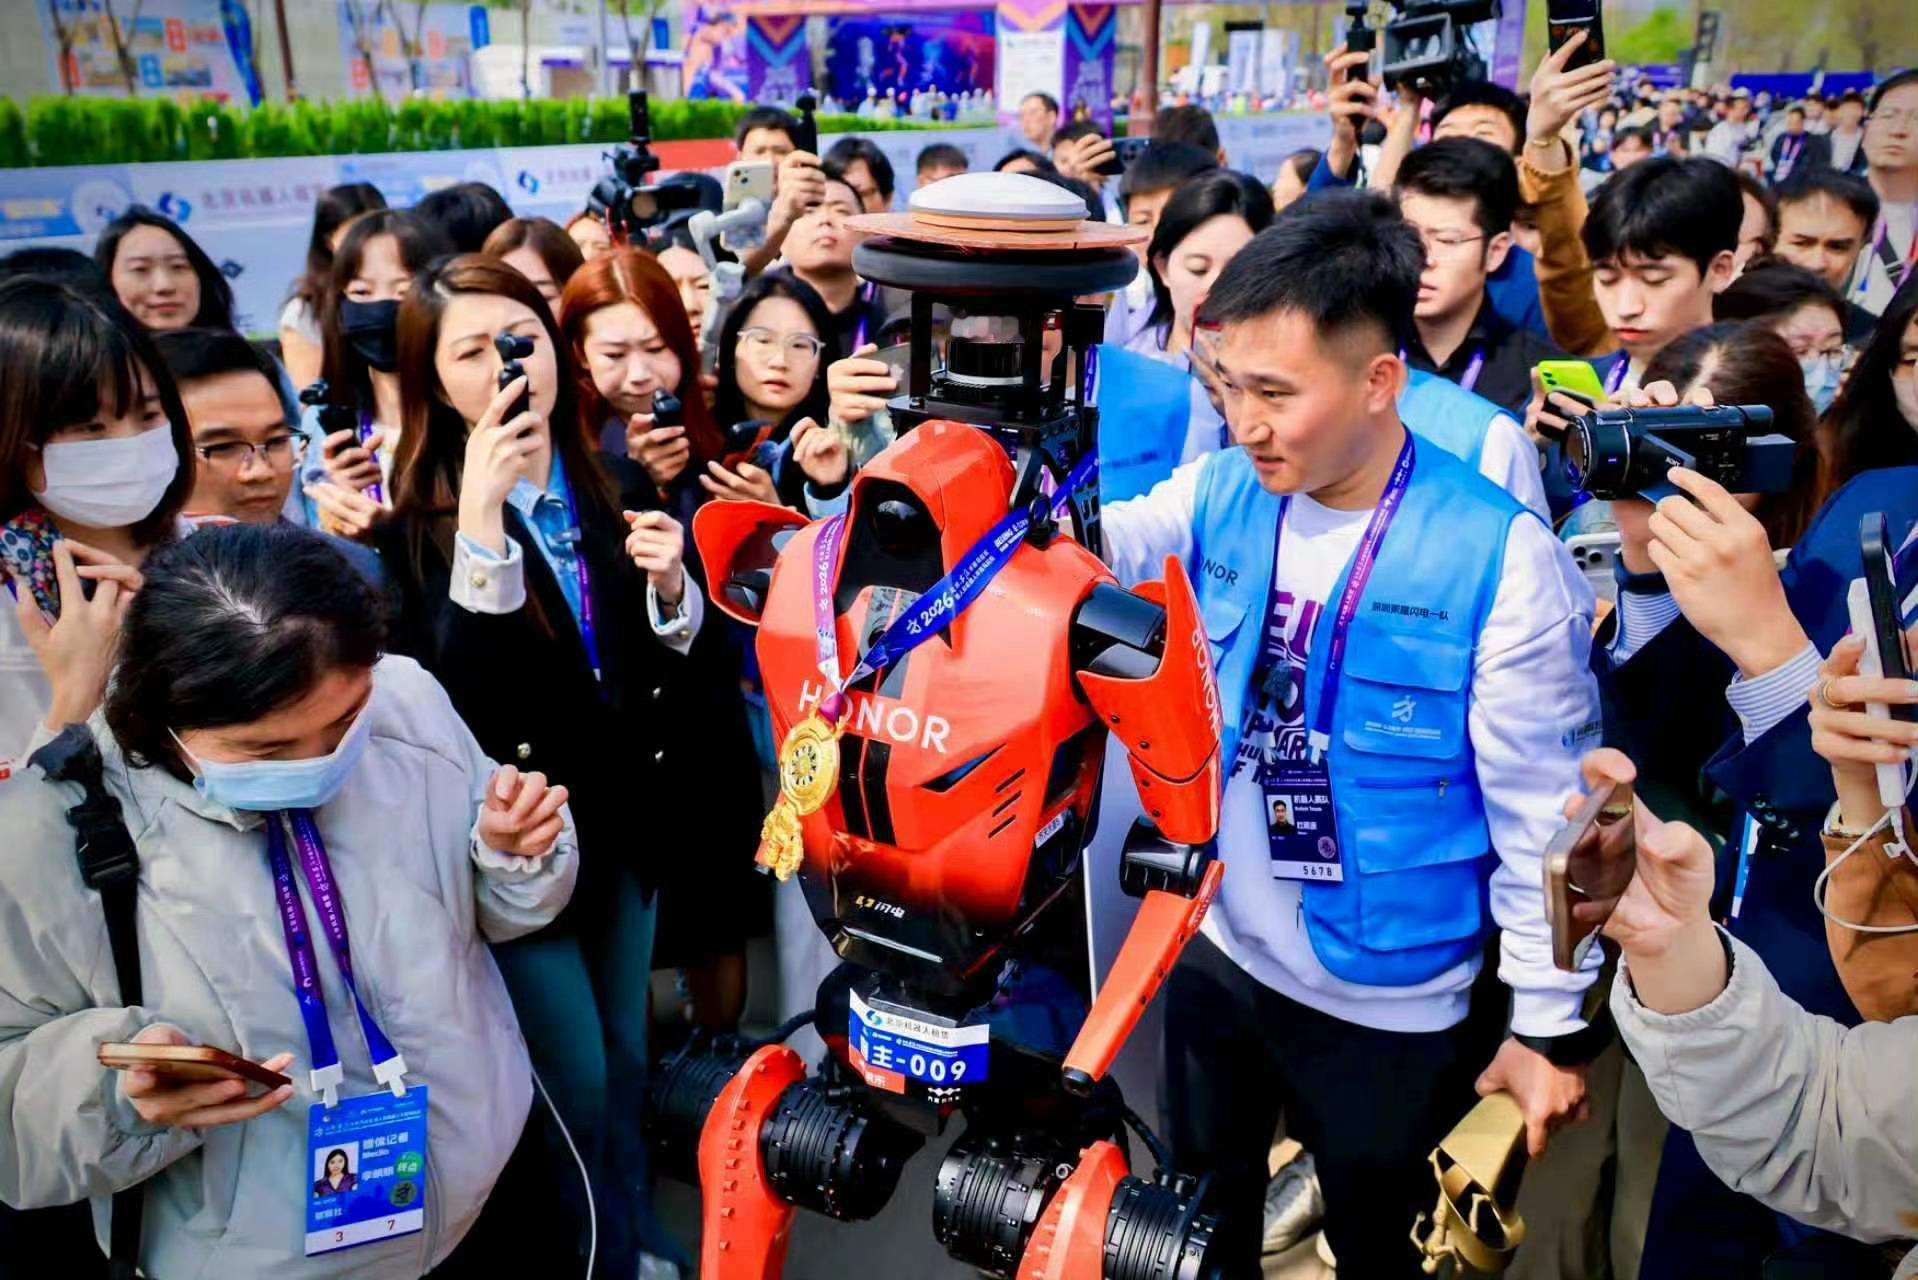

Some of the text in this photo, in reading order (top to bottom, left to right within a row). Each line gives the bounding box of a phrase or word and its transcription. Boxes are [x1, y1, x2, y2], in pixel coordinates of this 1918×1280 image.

[818, 561, 829, 596] 2026
[920, 591, 954, 628] 2026
[798, 680, 951, 754] HONOR
[335, 1231, 344, 1243] 3
[387, 1219, 396, 1231] 7
